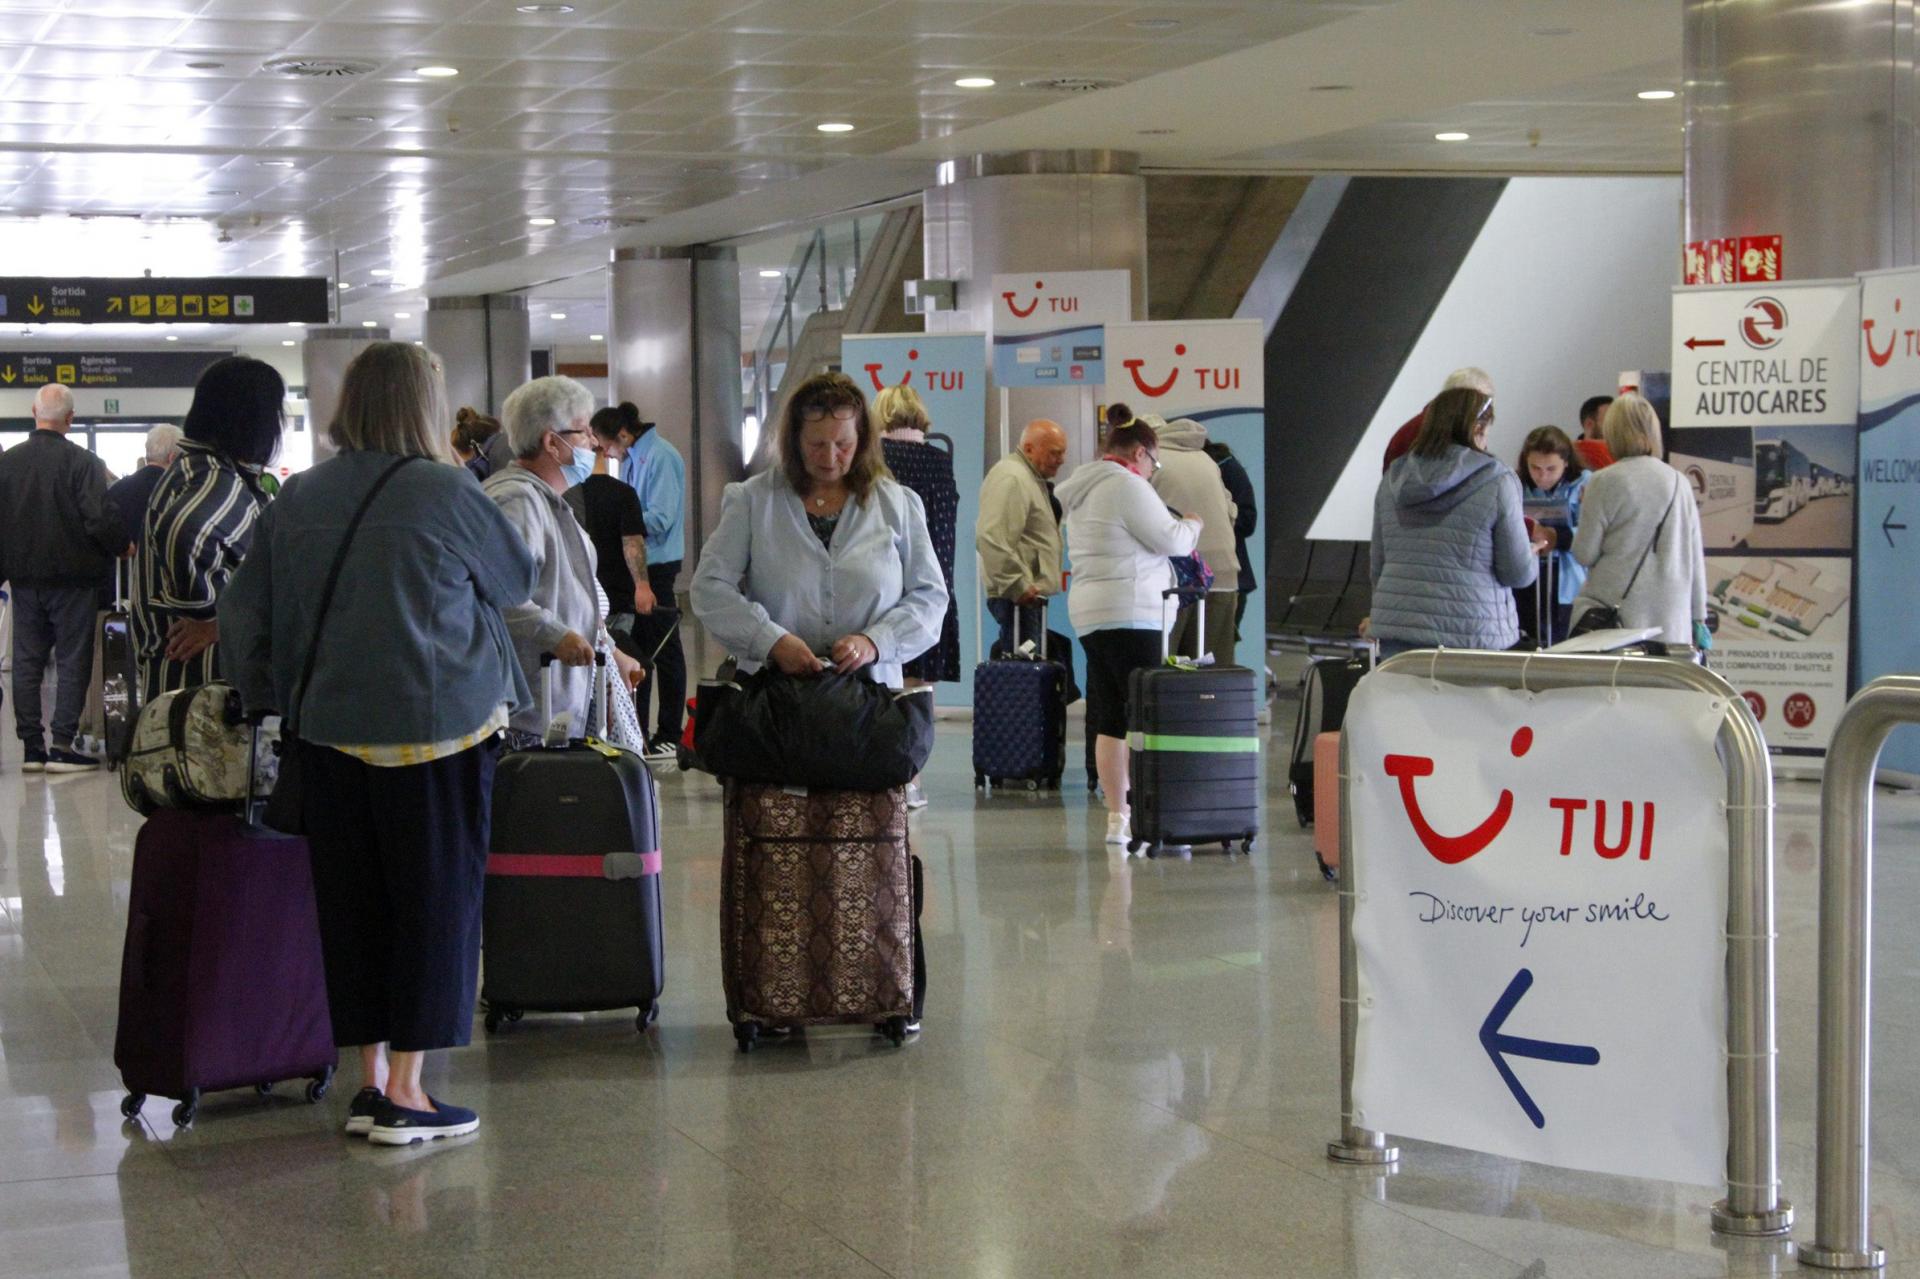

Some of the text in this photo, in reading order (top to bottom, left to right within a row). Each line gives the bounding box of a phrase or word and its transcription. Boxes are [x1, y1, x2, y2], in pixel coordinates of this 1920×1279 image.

[51, 286, 86, 296] Sortida
[53, 307, 81, 316] Salida
[1049, 298, 1079, 312] TUI
[925, 371, 964, 391] TUI
[1195, 368, 1240, 389] TUI
[1696, 357, 1828, 386] CENTRAL DE
[1696, 389, 1827, 416] AUTOCARES
[1727, 649, 1770, 659] PRIVADOS
[1549, 797, 1655, 861] TUI
[1409, 891, 1670, 948] Discover your smile
